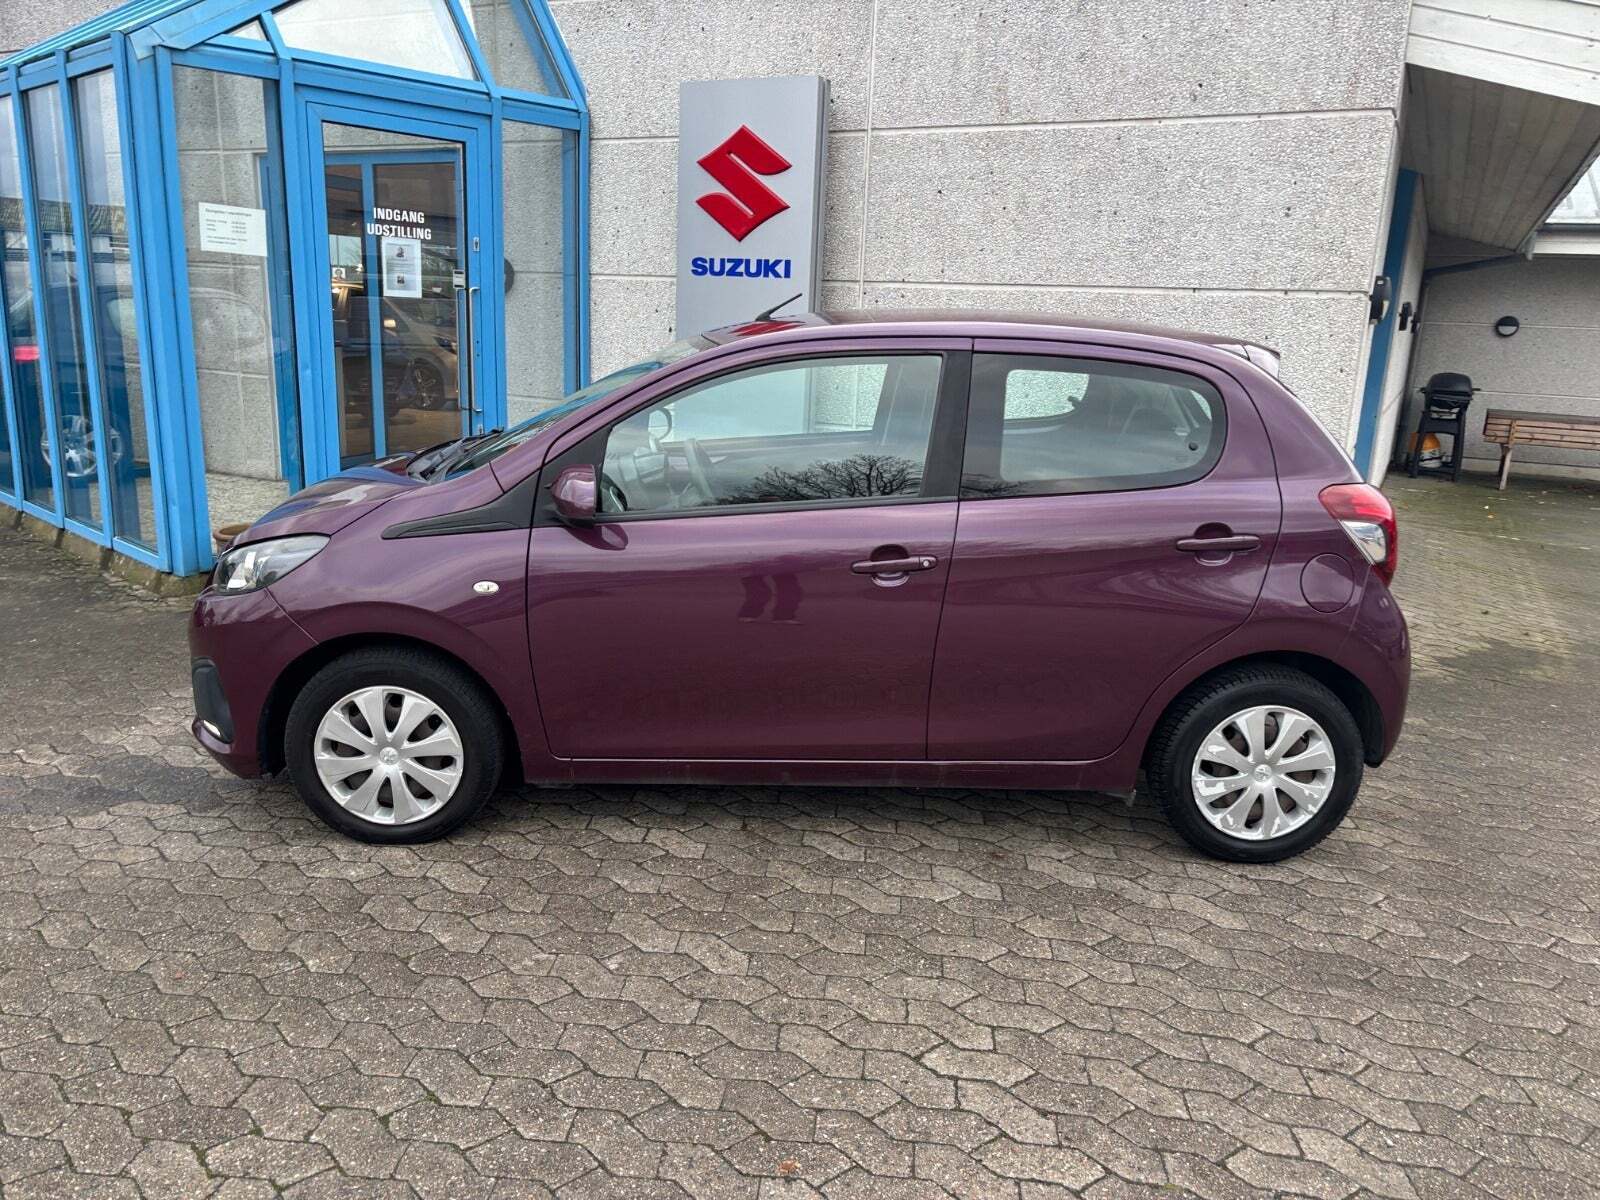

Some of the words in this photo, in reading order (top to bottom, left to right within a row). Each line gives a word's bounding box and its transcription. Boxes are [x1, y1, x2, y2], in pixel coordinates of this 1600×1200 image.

[373, 207, 425, 224] INDGANG
[366, 222, 432, 240] UDSTILLING
[691, 256, 792, 279] SUZUKI
